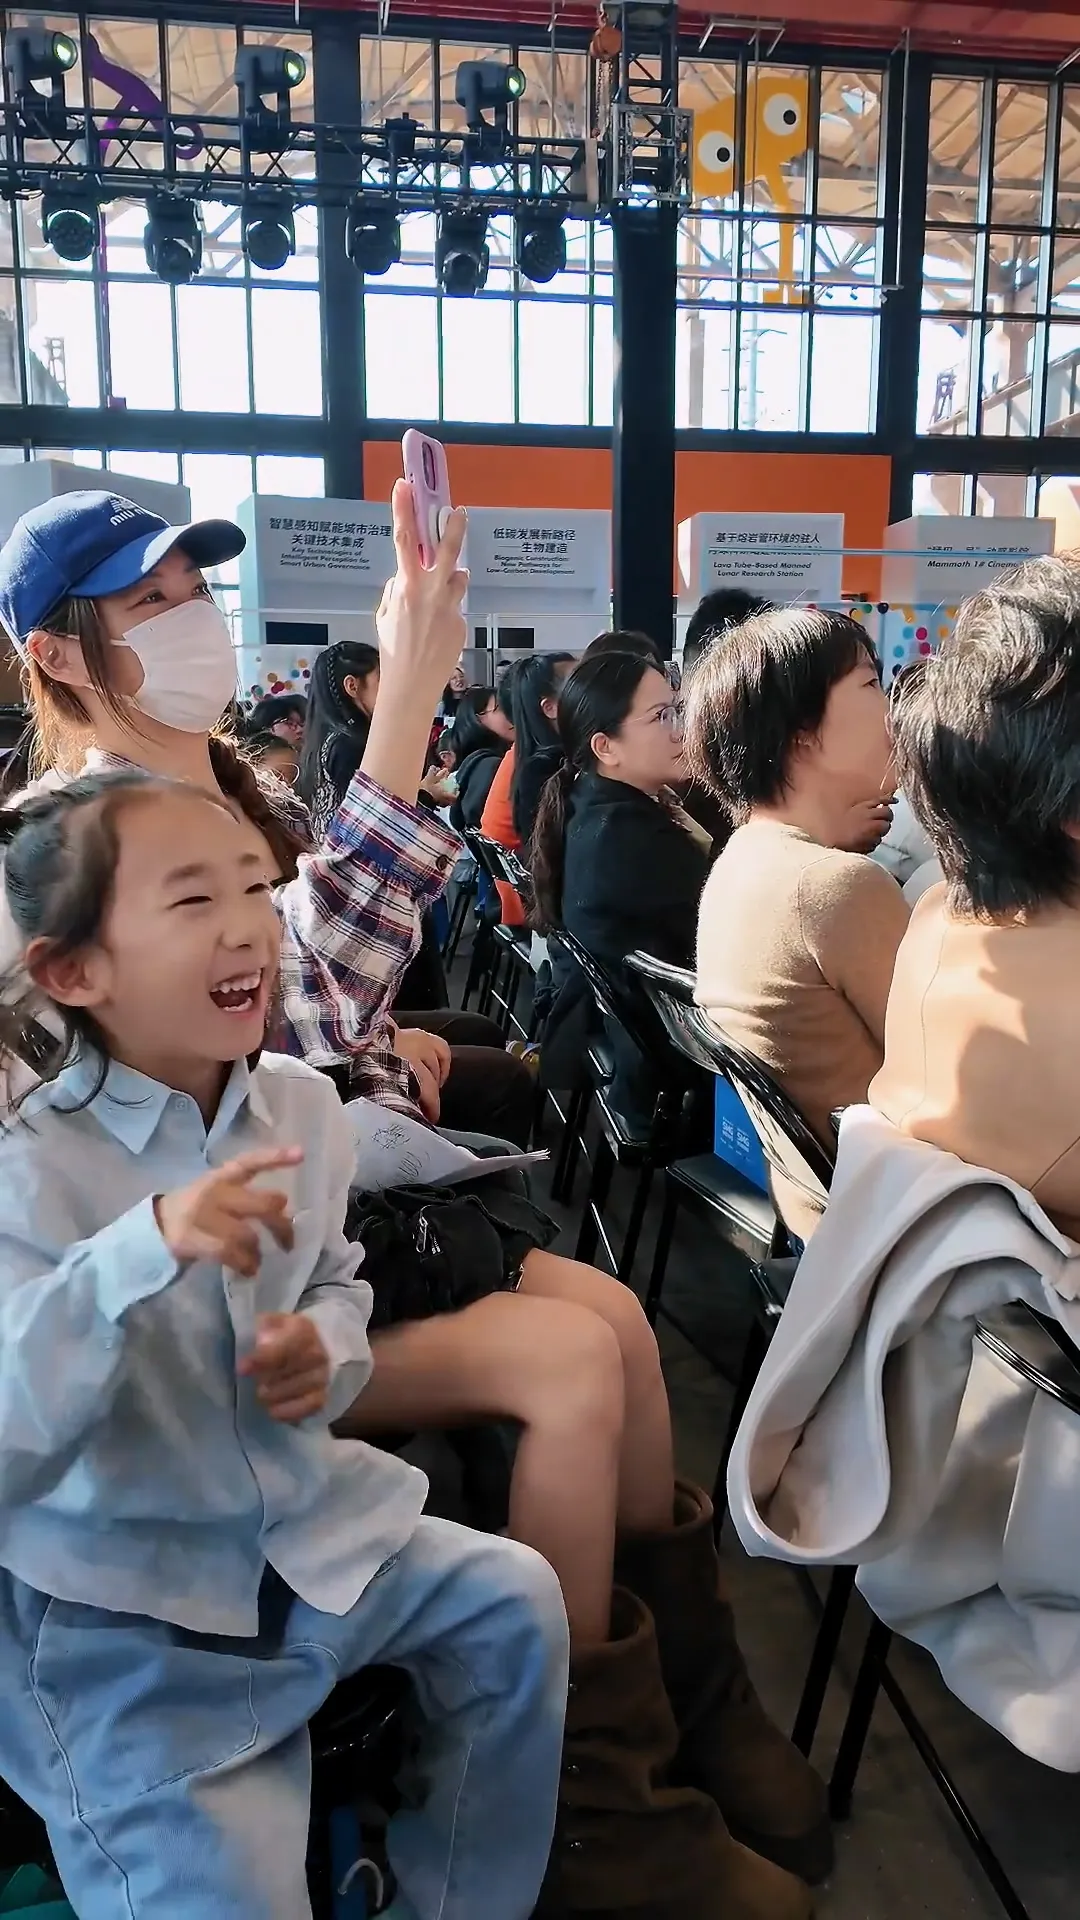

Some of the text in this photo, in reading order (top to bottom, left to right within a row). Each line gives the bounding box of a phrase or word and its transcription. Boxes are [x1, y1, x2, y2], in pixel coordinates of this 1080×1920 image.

[269, 517, 392, 537] 智慧感知赋能城市治理
[493, 527, 576, 541] 低碳发展新路径
[715, 532, 820, 544] 基于熔岩管环境的驻人
[291, 533, 365, 549] 关键技术集成
[291, 547, 305, 555] Key
[307, 547, 352, 556] Technologies
[281, 553, 318, 561] Intelligent
[320, 555, 357, 564] Perception
[493, 554, 524, 562] Biogenic
[280, 559, 301, 567] Smart
[327, 562, 370, 570] Governance
[734, 561, 778, 569] Tube-Based
[927, 560, 971, 568] Mammoth
